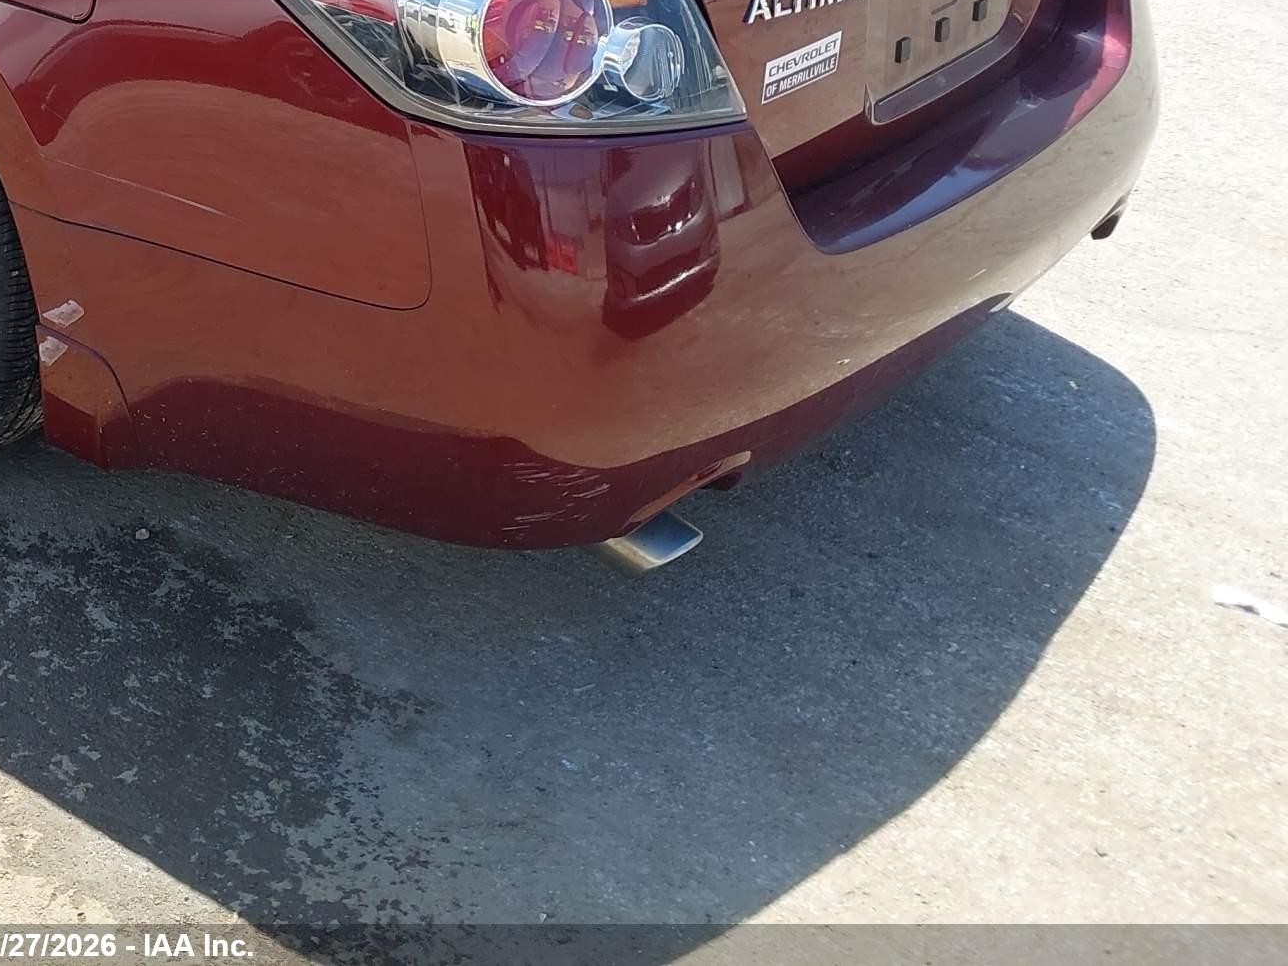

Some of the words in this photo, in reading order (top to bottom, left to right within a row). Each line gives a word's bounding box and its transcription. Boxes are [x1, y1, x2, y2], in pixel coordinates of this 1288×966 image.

[765, 82, 778, 98] OF
[779, 56, 837, 92] MERRILLVILLE
[768, 38, 839, 78] CHEVROLET
